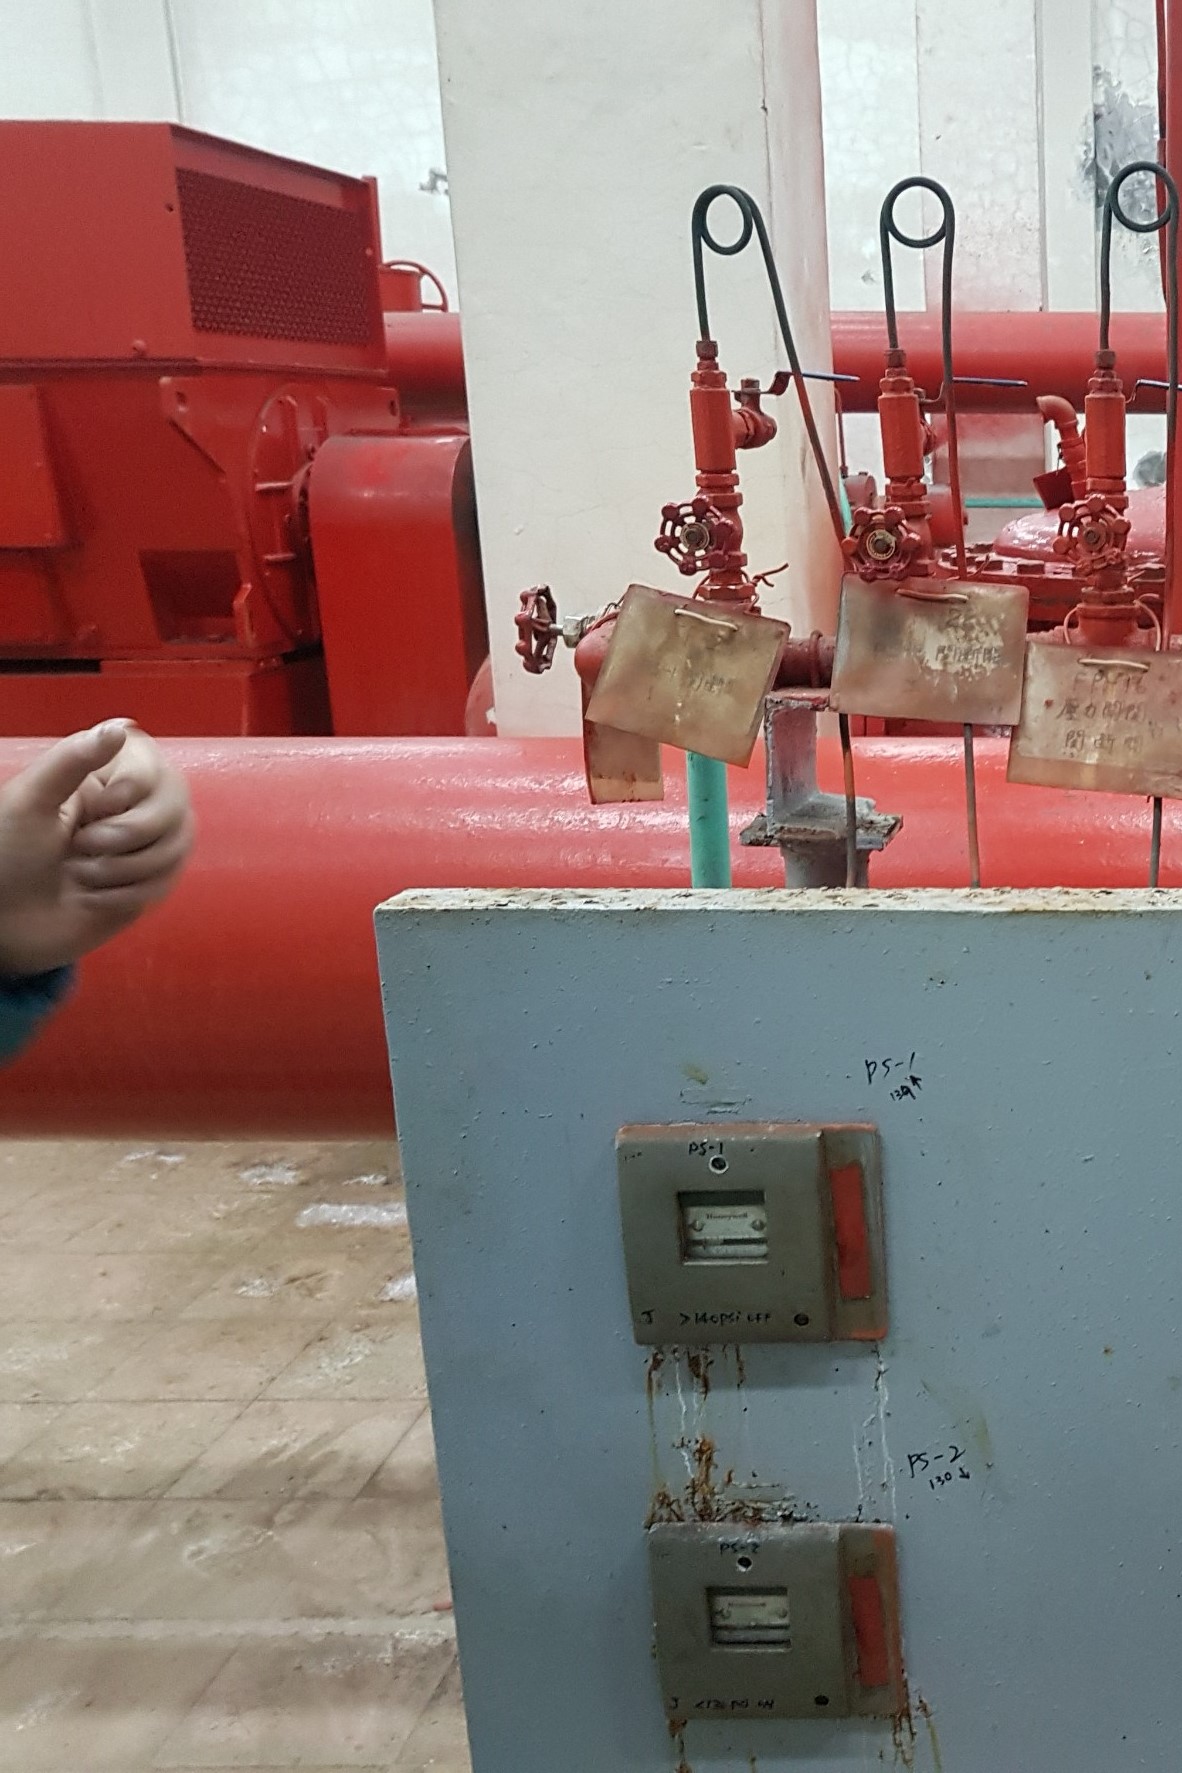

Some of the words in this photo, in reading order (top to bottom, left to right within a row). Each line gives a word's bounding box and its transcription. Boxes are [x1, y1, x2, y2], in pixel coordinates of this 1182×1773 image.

[705, 1212, 748, 1222] Honeywell
[907, 1445, 966, 1479] PS-2
[929, 1472, 953, 1491] 130
